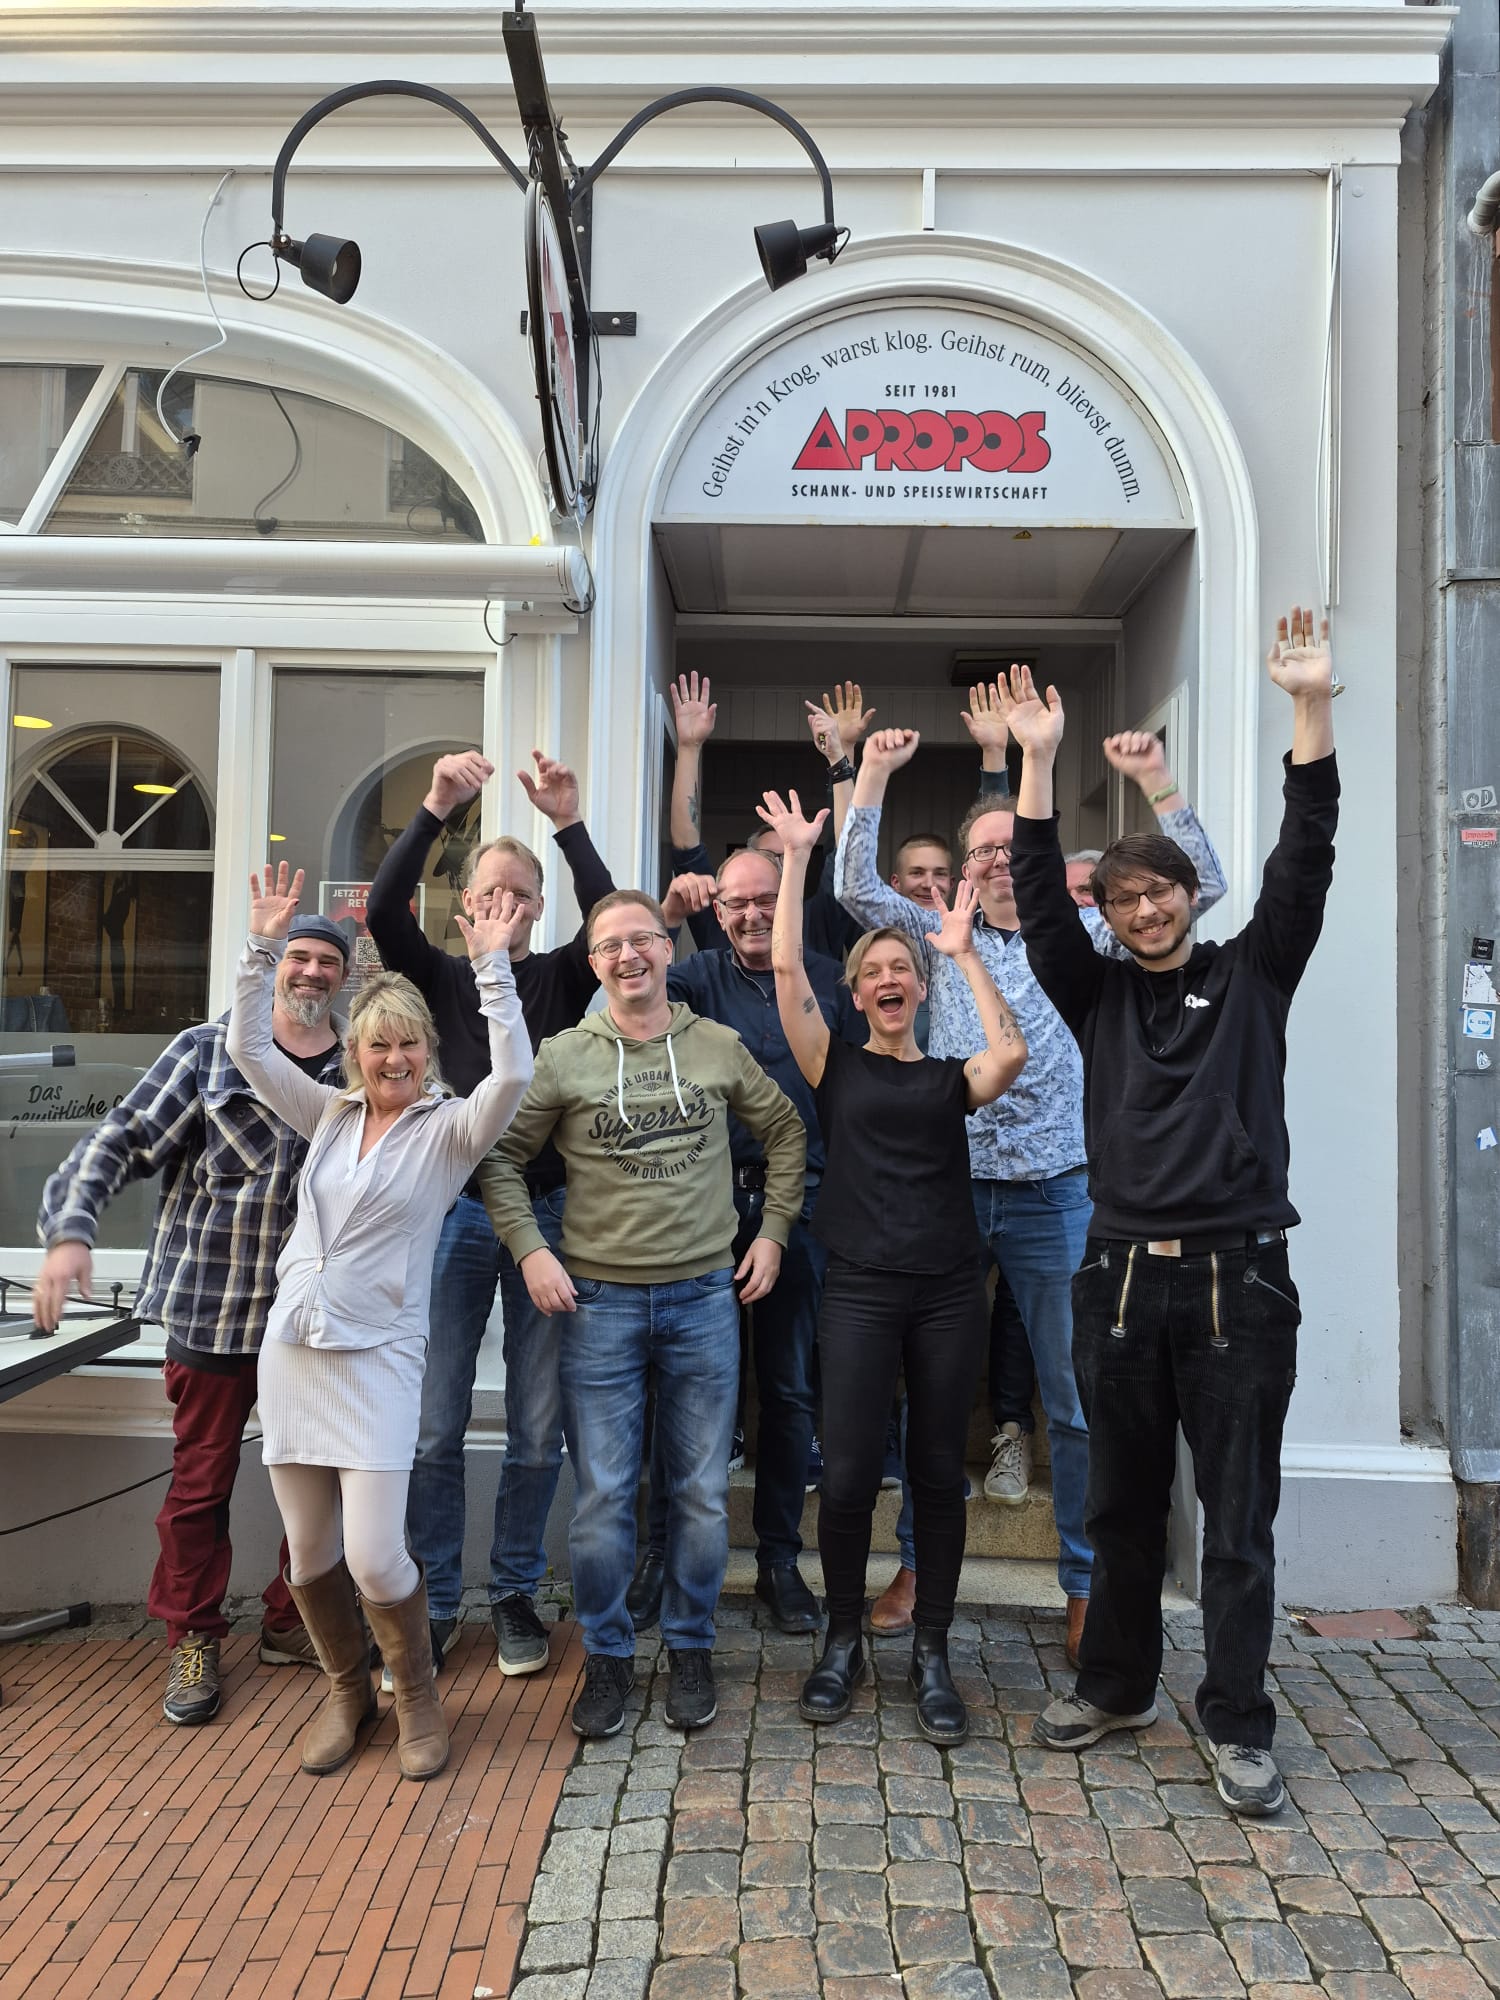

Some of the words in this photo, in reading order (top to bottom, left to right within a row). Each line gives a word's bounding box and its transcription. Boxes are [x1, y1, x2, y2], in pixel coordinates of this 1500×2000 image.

[885, 384, 916, 398] SEIT
[924, 384, 957, 398] 1981
[702, 435, 745, 498] Geihst
[735, 400, 772, 436] in'n
[766, 364, 820, 403] Krog,
[821, 335, 880, 370] warst
[885, 329, 933, 354] klog.
[940, 329, 1006, 362] Geihst
[1009, 352, 1051, 388] rum,
[1055, 376, 1112, 436] blievst
[1104, 436, 1141, 504] dumm.
[792, 406, 1051, 473] APROPOS
[791, 484, 857, 499] SCHANK-
[865, 485, 896, 499] UND
[903, 485, 1048, 500] SPEISEWIRTSCHAFT
[332, 889, 360, 898] JETZT
[348, 898, 367, 908] RET
[634, 1070, 670, 1083] URBAN
[672, 1075, 705, 1097] RAND
[27, 1084, 63, 1104] Das
[600, 1141, 640, 1177] PREMIUM
[642, 1159, 687, 1179] QUALITY
[690, 1133, 709, 1164] DENIM
